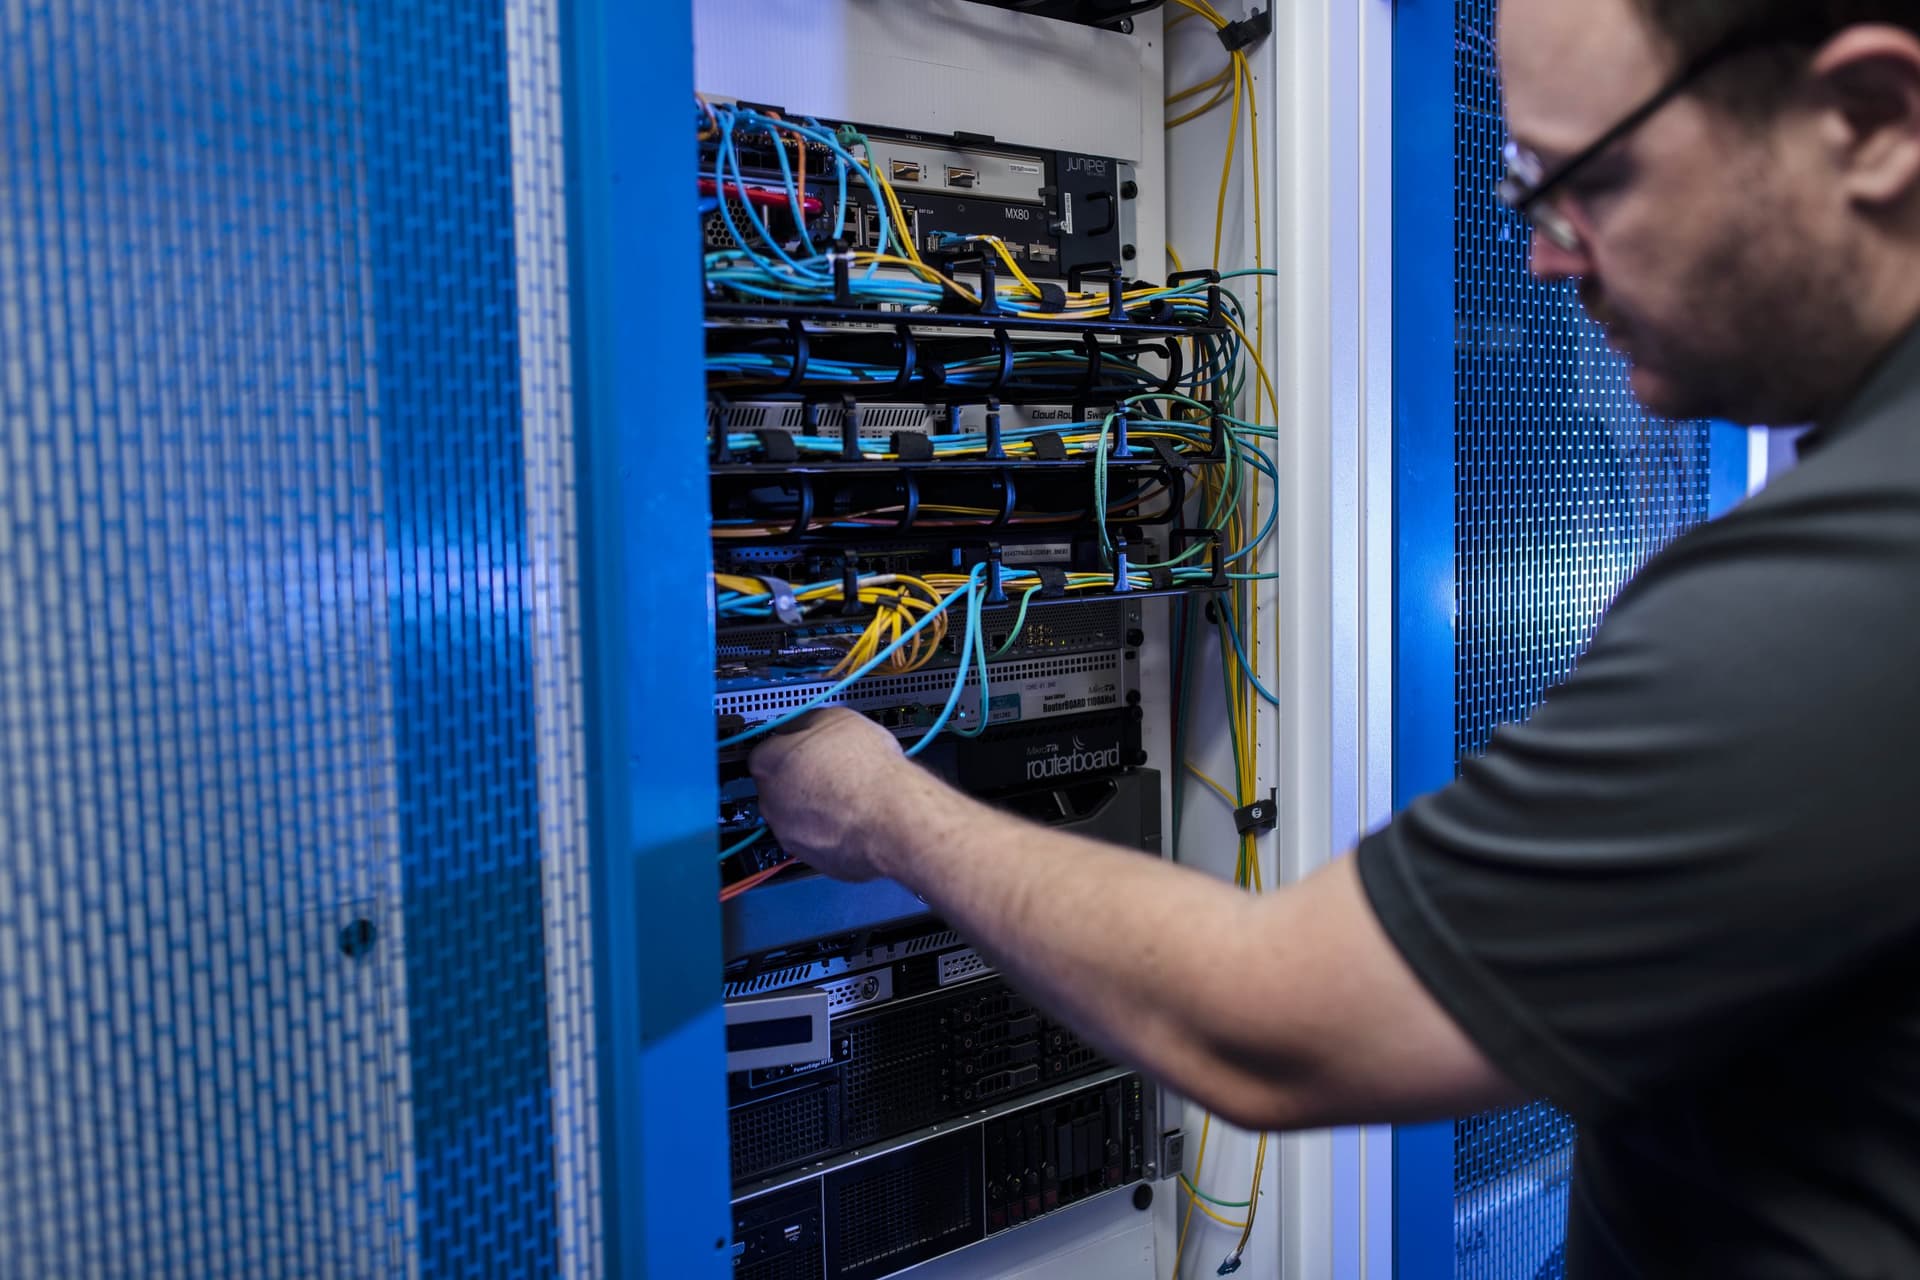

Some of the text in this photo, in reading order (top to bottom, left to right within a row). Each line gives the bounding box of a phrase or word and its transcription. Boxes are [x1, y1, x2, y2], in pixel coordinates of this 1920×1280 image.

[1005, 208, 1030, 220] MX80
[1032, 410, 1056, 420] Cloud
[1027, 741, 1120, 780] routerboard
